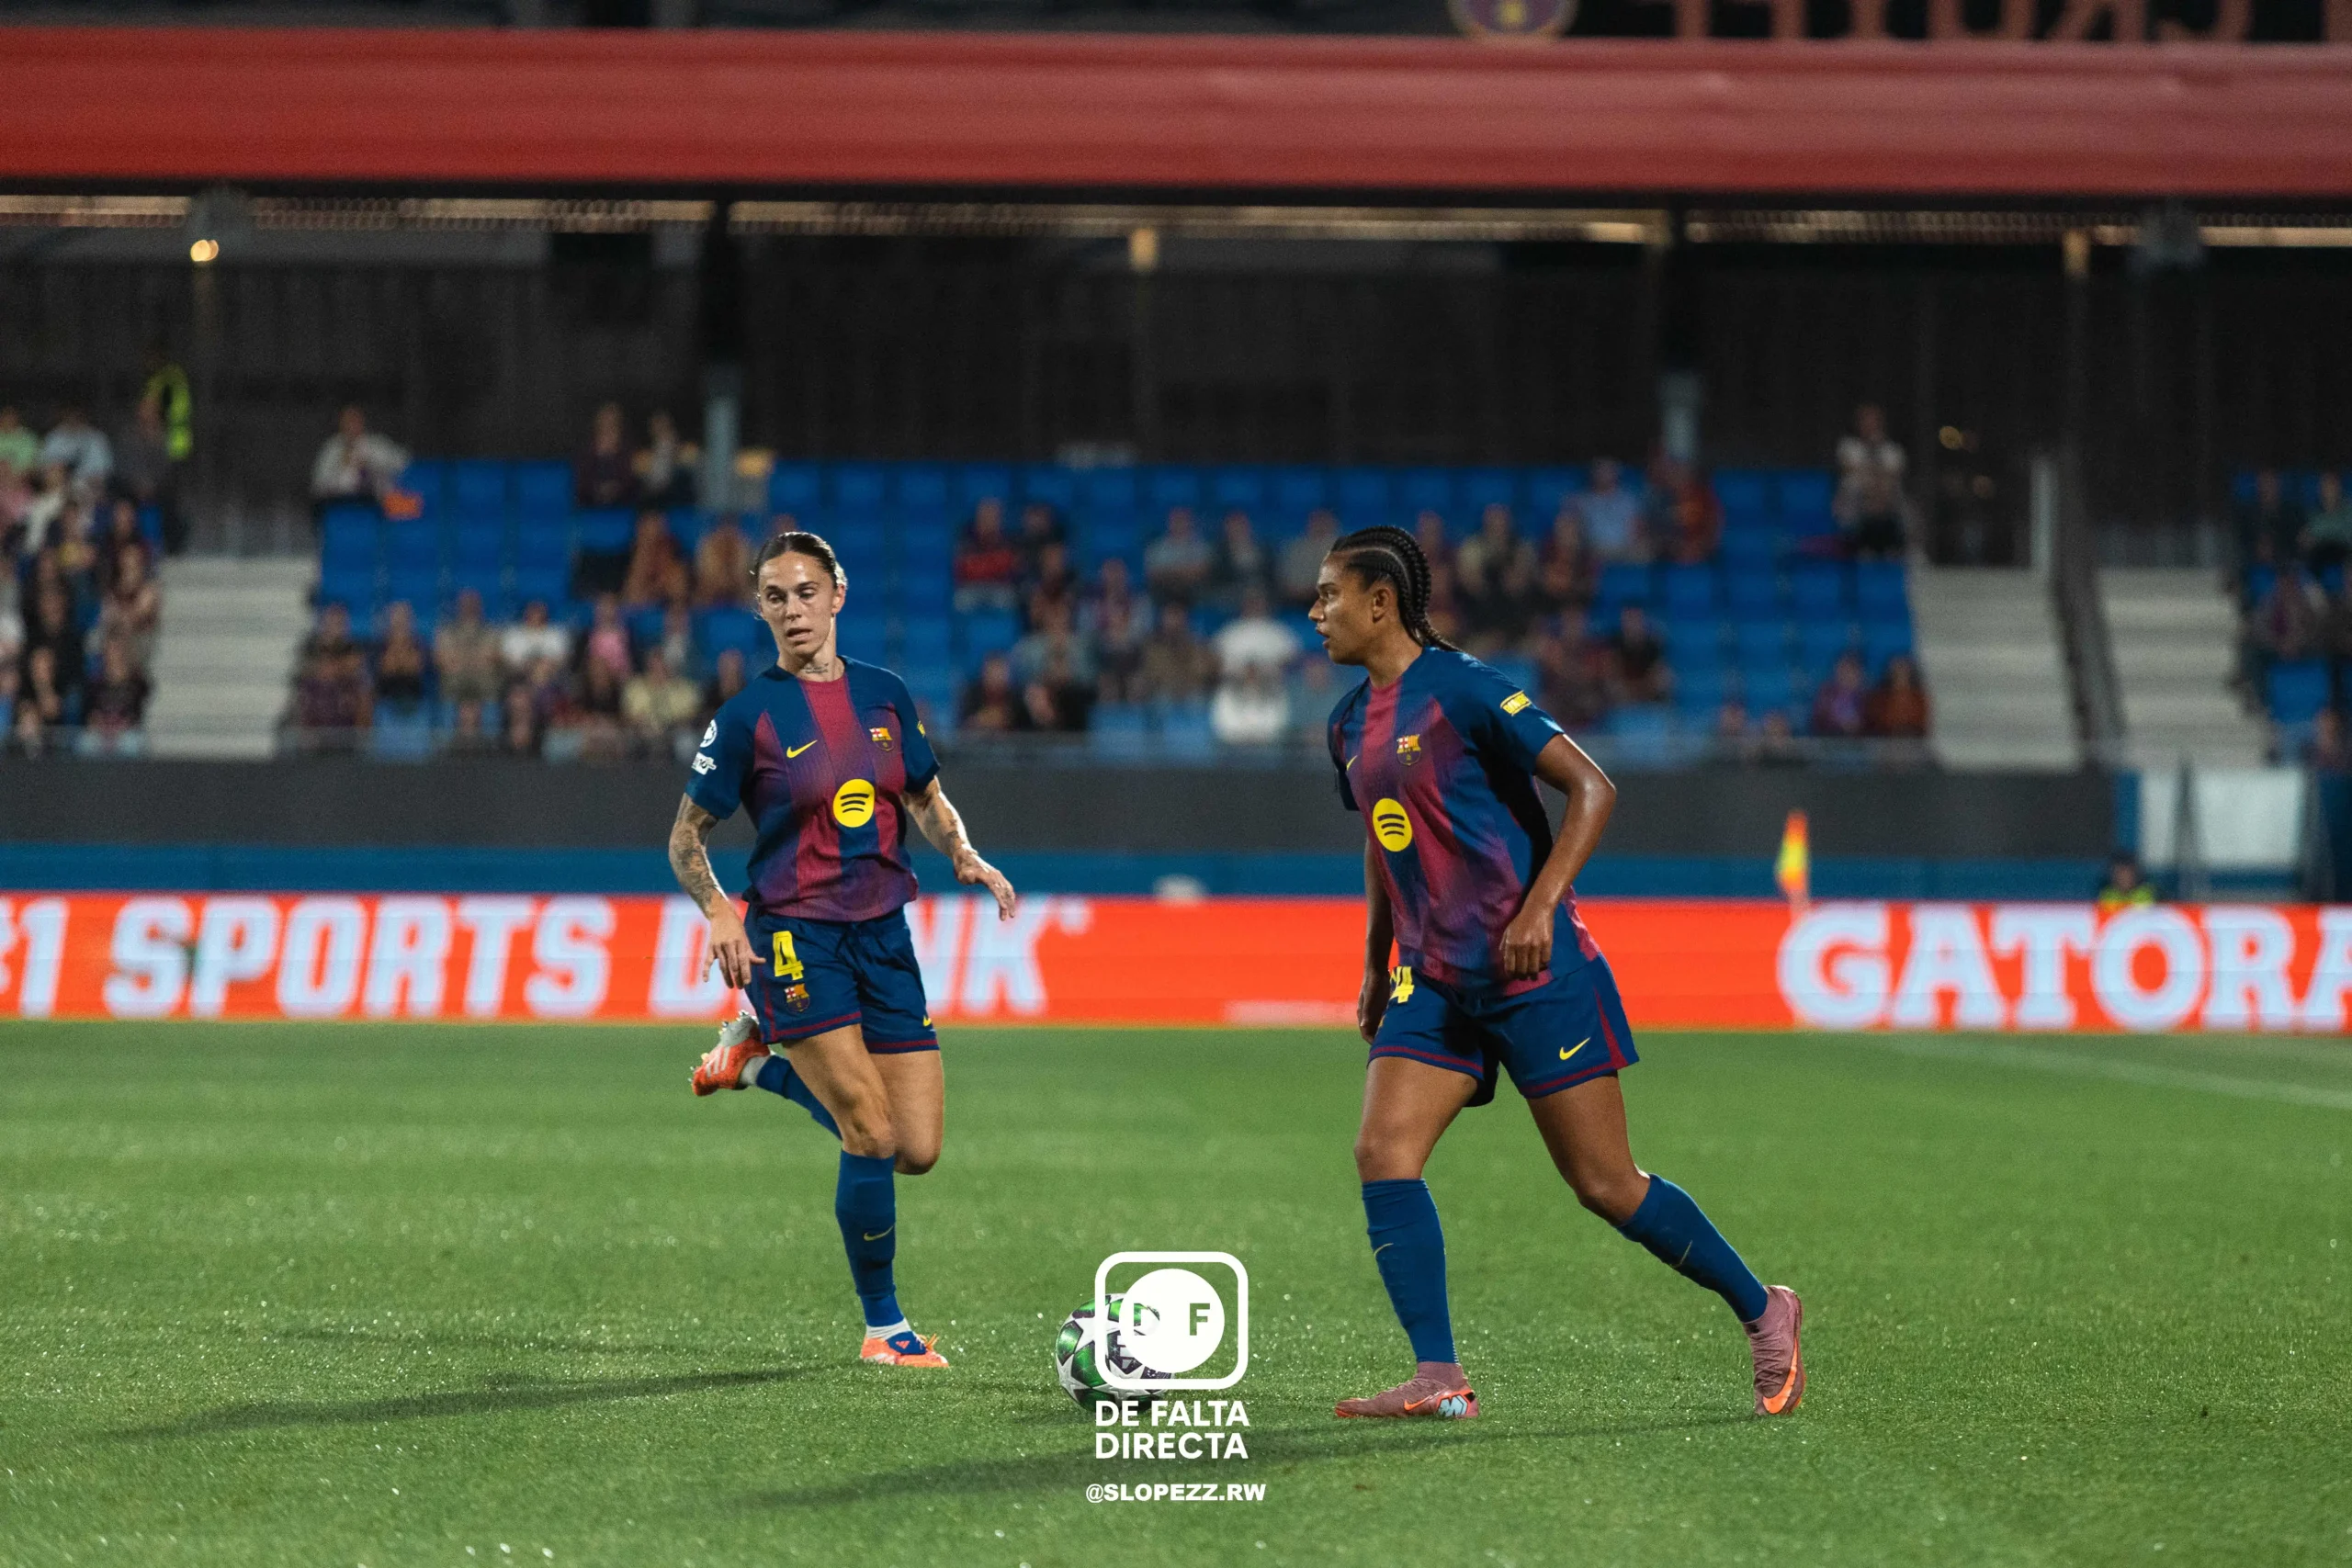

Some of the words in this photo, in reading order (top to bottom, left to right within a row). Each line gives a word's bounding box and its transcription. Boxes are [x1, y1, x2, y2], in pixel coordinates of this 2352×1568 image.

[0, 896, 68, 1018] 1
[103, 895, 616, 1018] SPORTS
[647, 895, 1054, 1020] DNK
[773, 931, 804, 981] 4
[1390, 965, 1415, 1004] 4
